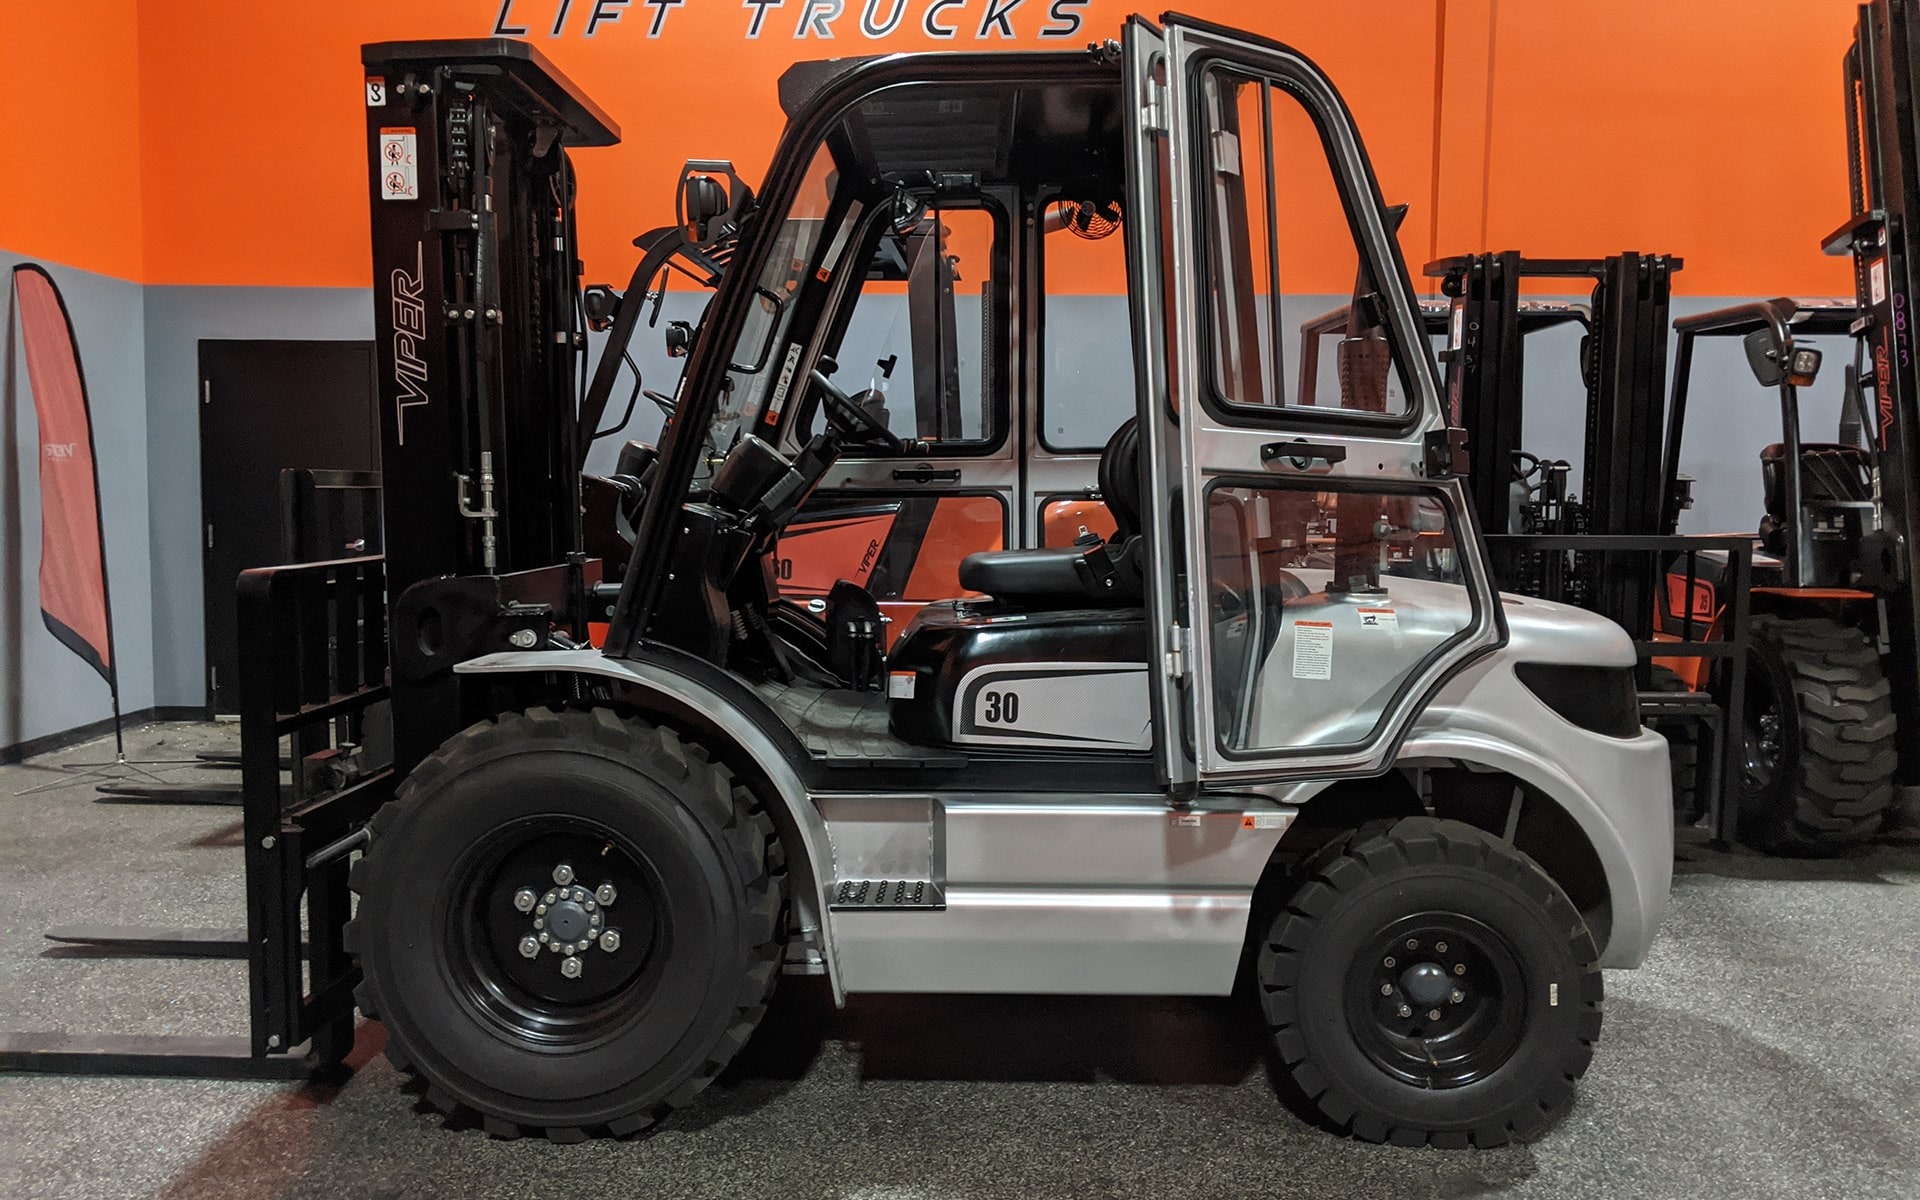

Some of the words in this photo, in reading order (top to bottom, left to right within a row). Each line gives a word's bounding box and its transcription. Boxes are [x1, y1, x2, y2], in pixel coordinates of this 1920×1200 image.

[491, 0, 687, 39] LIFT
[744, 0, 1093, 40] TRUCKS
[391, 241, 428, 446] VIPER
[1875, 325, 1894, 452] VIPER
[854, 538, 880, 579] VIPER
[985, 691, 1019, 723] 30
